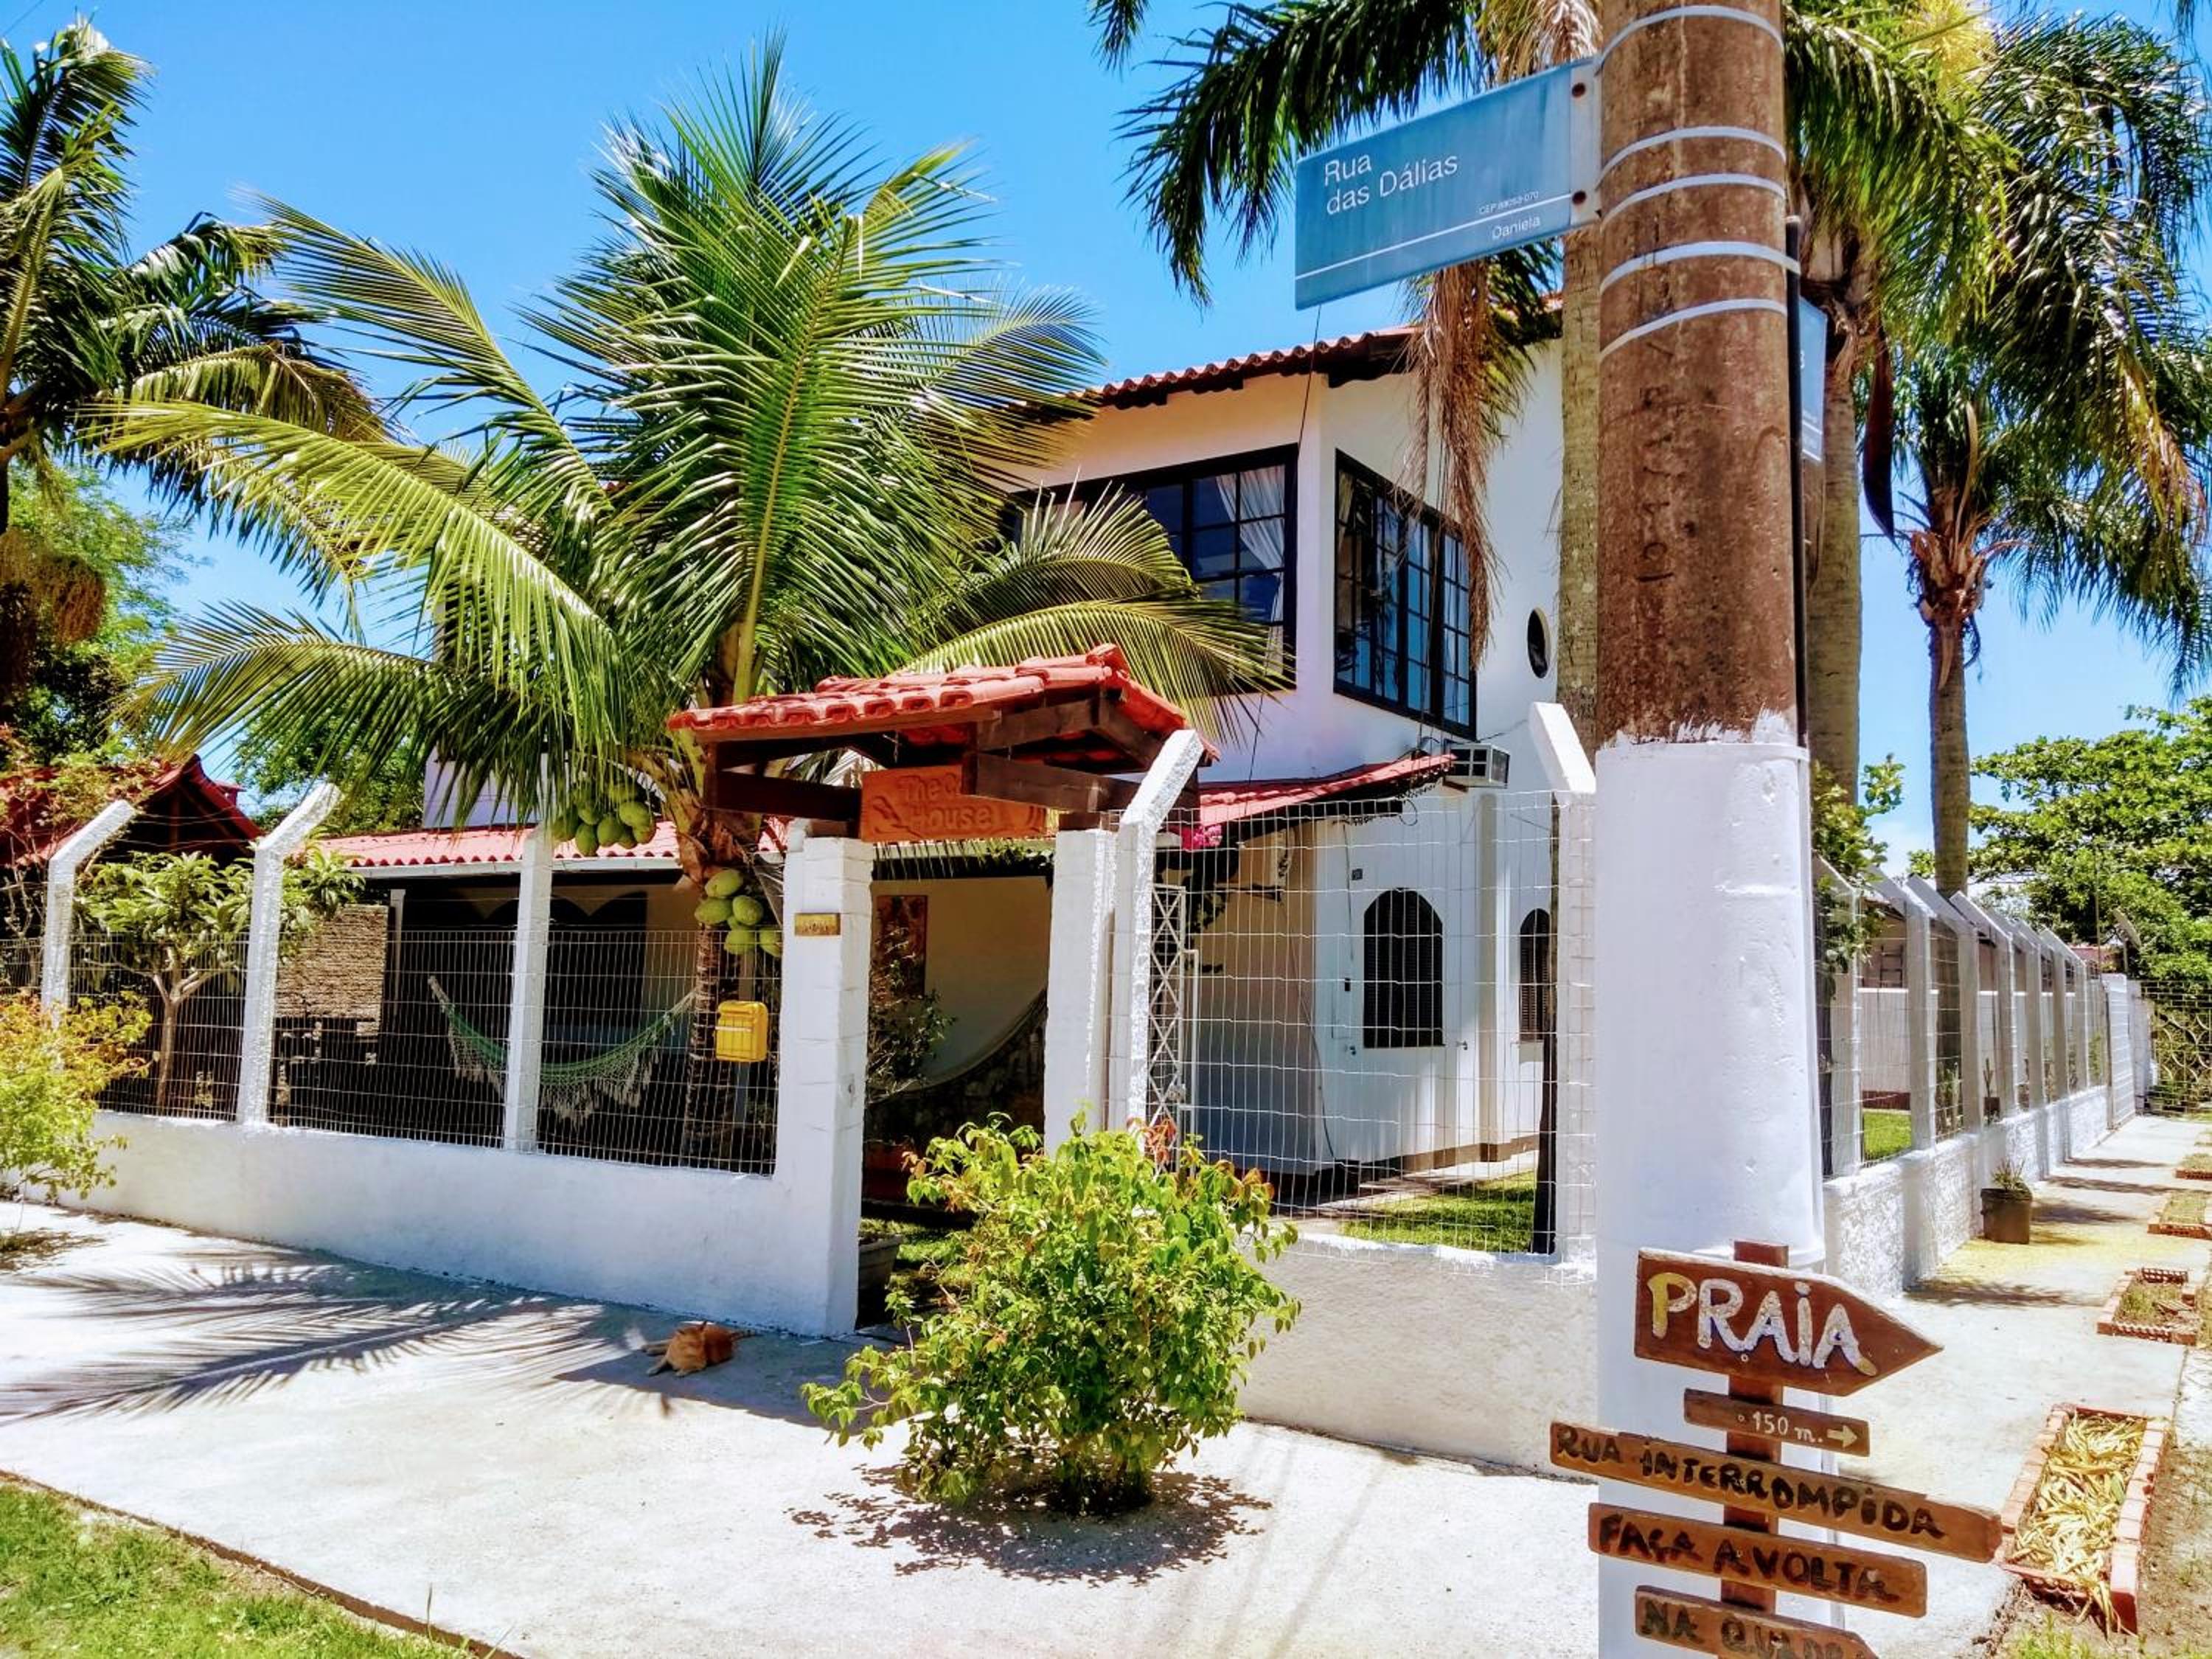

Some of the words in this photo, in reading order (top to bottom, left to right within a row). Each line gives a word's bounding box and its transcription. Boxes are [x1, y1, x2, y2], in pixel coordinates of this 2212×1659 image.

[1324, 154, 1372, 187] Rua
[1326, 184, 1371, 215] das
[1380, 155, 1458, 198] Dálias
[1492, 215, 1540, 240] Daniela
[897, 774, 940, 802] The
[908, 801, 994, 830] House
[1753, 1411, 1789, 1436] 150
[1557, 1425, 1621, 1463] RUA
[1639, 1599, 1704, 1644] NA
